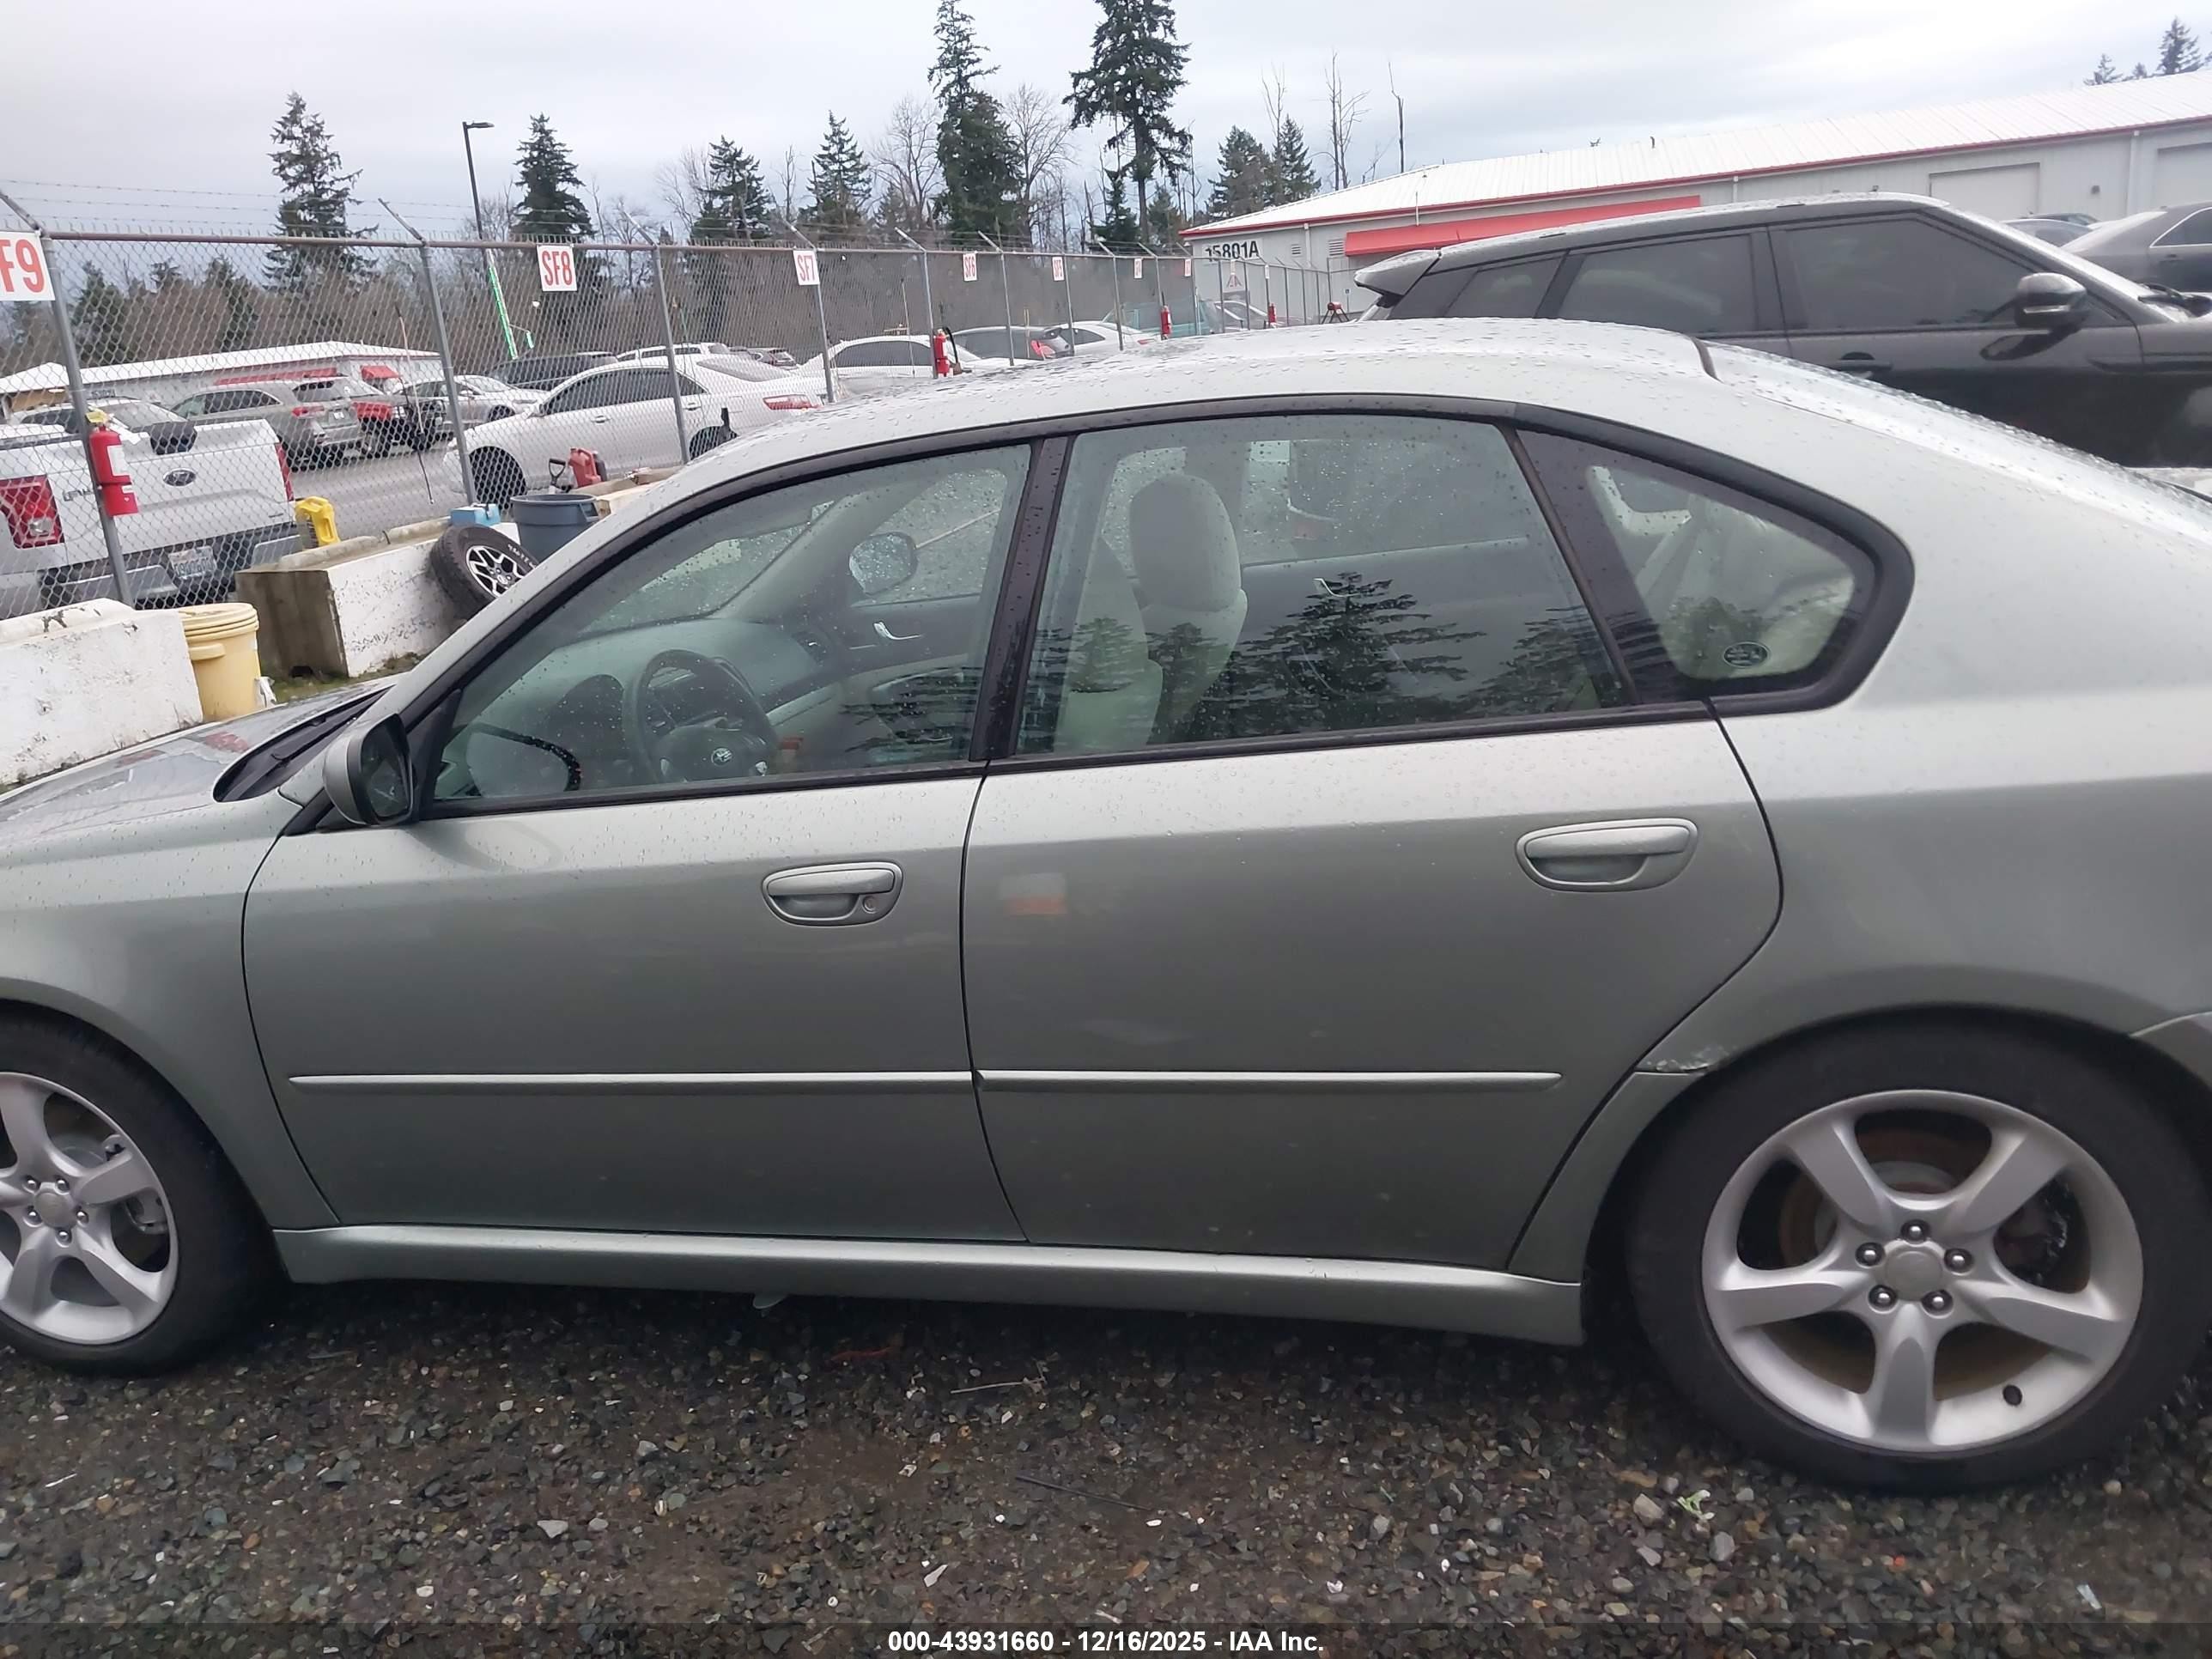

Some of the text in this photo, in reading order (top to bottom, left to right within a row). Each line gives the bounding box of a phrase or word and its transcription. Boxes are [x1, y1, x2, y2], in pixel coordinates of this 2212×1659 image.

[1205, 240, 1260, 262] 15801A
[541, 250, 573, 286] SF8
[797, 254, 815, 282] SF7
